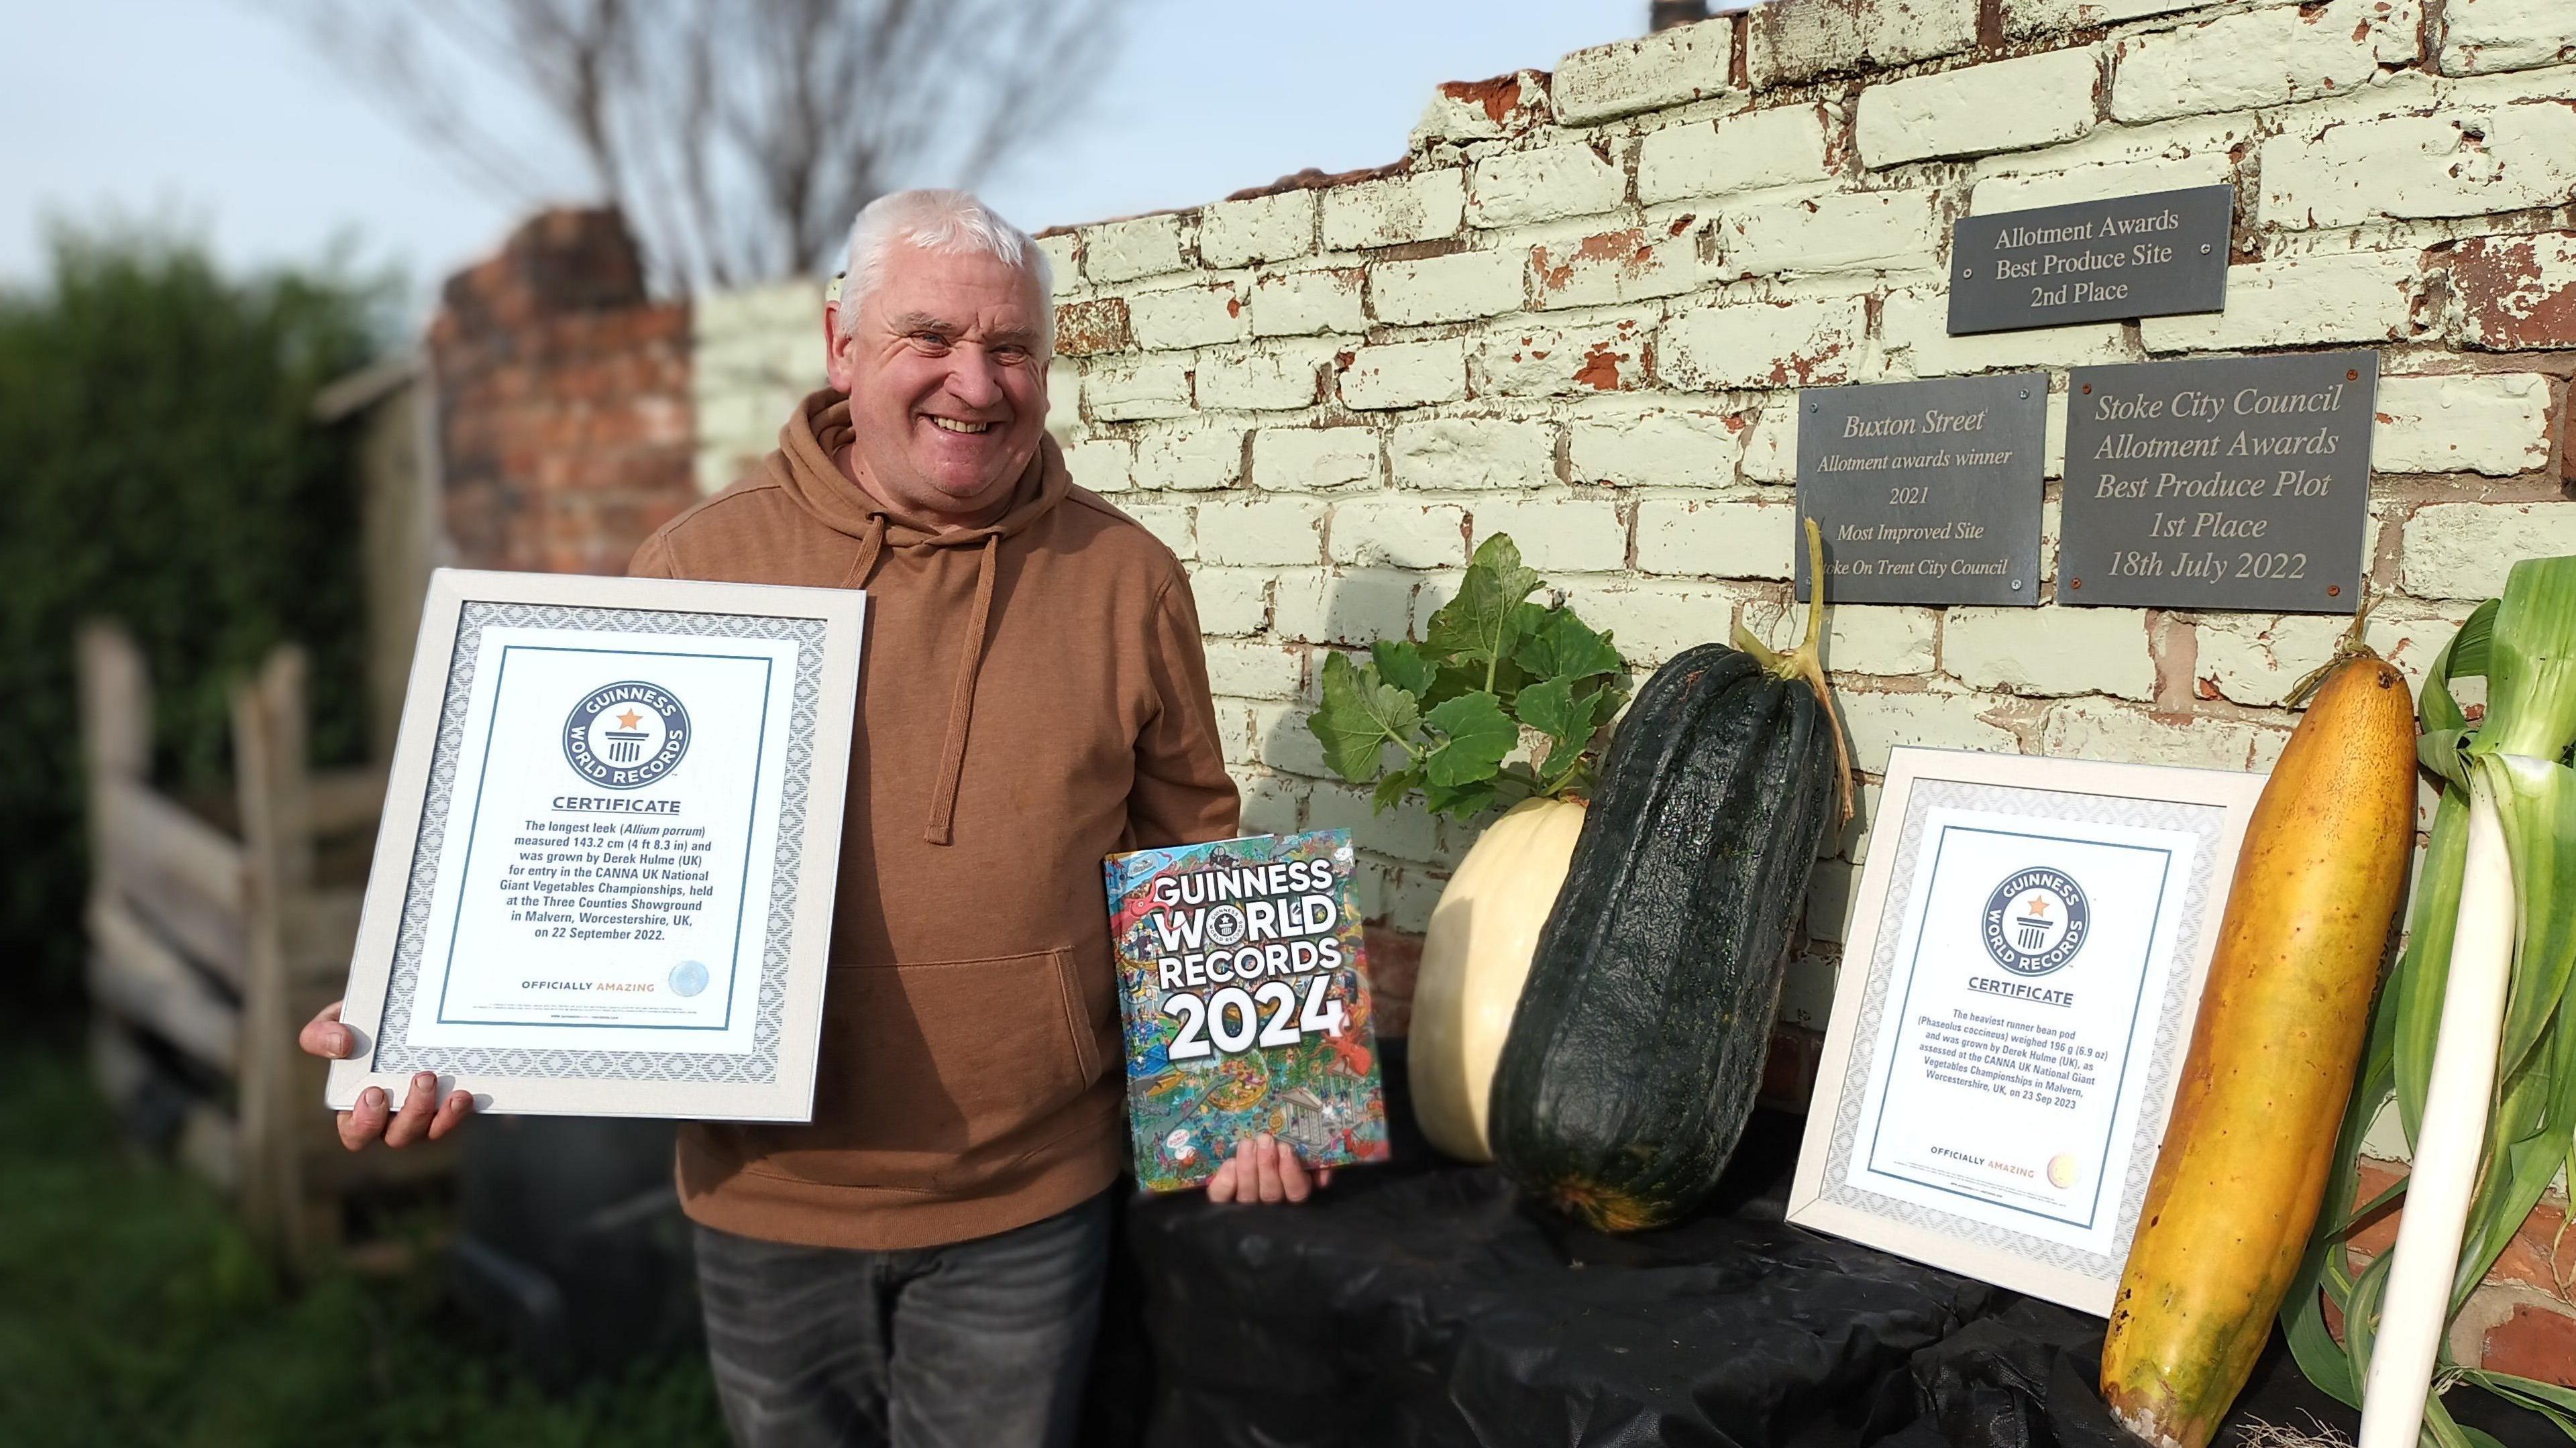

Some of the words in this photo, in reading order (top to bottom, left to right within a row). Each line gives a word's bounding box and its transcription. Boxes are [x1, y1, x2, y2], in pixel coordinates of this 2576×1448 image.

[1994, 222, 2093, 249] Allotment
[2098, 209, 2178, 237] Awards
[1996, 259, 2037, 280] Best
[2043, 250, 2125, 275] Produce
[2132, 245, 2171, 266] Site
[2031, 284, 2067, 307] 2nd
[2073, 282, 2128, 303] Place
[2095, 394, 2163, 420] Stoke
[2171, 392, 2224, 423] City
[2234, 384, 2343, 414] Council
[1843, 416, 1916, 437] Buxton
[2094, 433, 2220, 459] Allotment
[2226, 427, 2339, 455] Awards
[1817, 455, 1888, 472] Allotment
[1892, 449, 1950, 469] awards
[1955, 448, 2012, 466] winner
[1889, 487, 1928, 504] 2021
[2094, 474, 2149, 498] Best
[2155, 471, 2265, 497] Produce
[2272, 470, 2332, 496] Plot
[1837, 524, 1874, 541] Most
[1877, 522, 1952, 544] Improved
[1955, 522, 1984, 539] Site
[2149, 512, 2186, 537] 1st
[2192, 512, 2267, 537] Place
[1853, 559, 1872, 575] On
[1878, 559, 1913, 575] Trent
[1918, 559, 1947, 579] City
[1951, 559, 2008, 575] Council
[2108, 551, 2163, 576] 18th
[2171, 552, 2227, 584] July
[2235, 553, 2306, 579] 2022
[586, 687, 676, 716] GUINNESS
[571, 726, 607, 779] WORLD
[613, 730, 684, 783] RECORDS
[553, 796, 681, 813] CERTIFICATE
[525, 820, 545, 831] The
[549, 821, 590, 834] longest
[593, 822, 616, 833] leek
[620, 824, 659, 836] (Allium
[661, 826, 705, 838] porrum)
[515, 836, 570, 846] measured
[574, 837, 604, 848] 143.2
[607, 840, 624, 848] cm
[628, 839, 638, 850] (4
[642, 839, 651, 849] ft
[654, 840, 670, 850] 8.3
[674, 840, 688, 852] in)
[692, 841, 712, 851] and
[509, 865, 525, 875] for
[528, 867, 557, 879] entry
[560, 866, 570, 877] in
[574, 867, 592, 877] the
[596, 867, 638, 879] CANNA
[643, 869, 659, 879] UK
[661, 869, 709, 881] National
[520, 852, 543, 860] was
[547, 854, 583, 863] grown
[586, 852, 600, 865] by
[603, 852, 636, 864] Derek
[639, 854, 675, 865] Hulme
[679, 855, 702, 868] (UK)
[500, 879, 529, 891] Giant
[533, 881, 594, 894] Vegetables
[598, 882, 685, 897] Championships,
[690, 885, 713, 896] held
[1153, 858, 1333, 907] GUINNESS
[2003, 874, 2080, 906] GUINNESS
[506, 897, 518, 905] at
[521, 895, 539, 906] the
[543, 896, 575, 907] Three
[579, 897, 627, 909] Counties
[631, 899, 702, 912] Showground
[511, 910, 521, 921] in
[525, 911, 574, 924] Malvern,
[580, 912, 669, 926] Worcestershire,
[674, 915, 692, 927] UK,
[1153, 893, 1338, 952] WORLD
[535, 929, 548, 937] on
[551, 927, 566, 938] 22
[570, 928, 631, 941] September
[634, 930, 665, 940] 2022.
[1988, 909, 2015, 962] WORLD
[2019, 920, 2082, 970] RECORDS
[1159, 938, 1342, 990] RECORDS
[521, 981, 593, 991] OFFICIALLY
[596, 983, 654, 992] AMAZING
[1969, 977, 2074, 1005] CERTIFICATE
[1162, 975, 1342, 1060] 2024
[1953, 1009, 1968, 1019] The
[1970, 1012, 2004, 1027] heaviest
[2006, 1021, 2035, 1032] runner
[2036, 1024, 2057, 1036] bean
[2059, 1031, 2076, 1040] pod
[1918, 1016, 1962, 1032] (Phaseolus
[1964, 1027, 2008, 1042] coccineus)
[2011, 1036, 2047, 1048] weighed
[2051, 1041, 2065, 1052] 196
[2068, 1046, 2073, 1055] g
[2076, 1046, 2093, 1057] (6.9
[2095, 1051, 2108, 1062] oz)
[1925, 1032, 1941, 1040] and
[1943, 1036, 1959, 1044] was
[1962, 1040, 1988, 1050] grown
[1990, 1043, 2000, 1054] by
[2002, 1045, 2027, 1058] Derek
[2029, 1050, 2057, 1064] Hulme
[2059, 1056, 2080, 1069] (UK),
[2083, 1063, 2094, 1071] as
[1919, 1044, 1957, 1057] assessed
[1969, 1052, 1982, 1062] the
[1984, 1055, 2015, 1069] CANNA
[2019, 1062, 2031, 1072] UK
[2033, 1065, 2070, 1080] National
[2072, 1072, 2095, 1085] Giant
[1925, 1056, 1968, 1072] Vegetables
[1970, 1066, 2033, 1087] Championships
[2035, 1079, 2043, 1089] in
[2045, 1081, 2083, 1098] Malvern,
[1927, 1069, 1990, 1092] Worcestershire,
[1993, 1084, 2006, 1095] UK,
[2010, 1089, 2021, 1097] on
[2023, 1090, 2033, 1100] 23
[2035, 1093, 2052, 1106] Sep
[2054, 1097, 2076, 1109] 2023
[1931, 1146, 1985, 1166] OFFICIALLY
[1988, 1160, 2034, 1178] AMAZING
